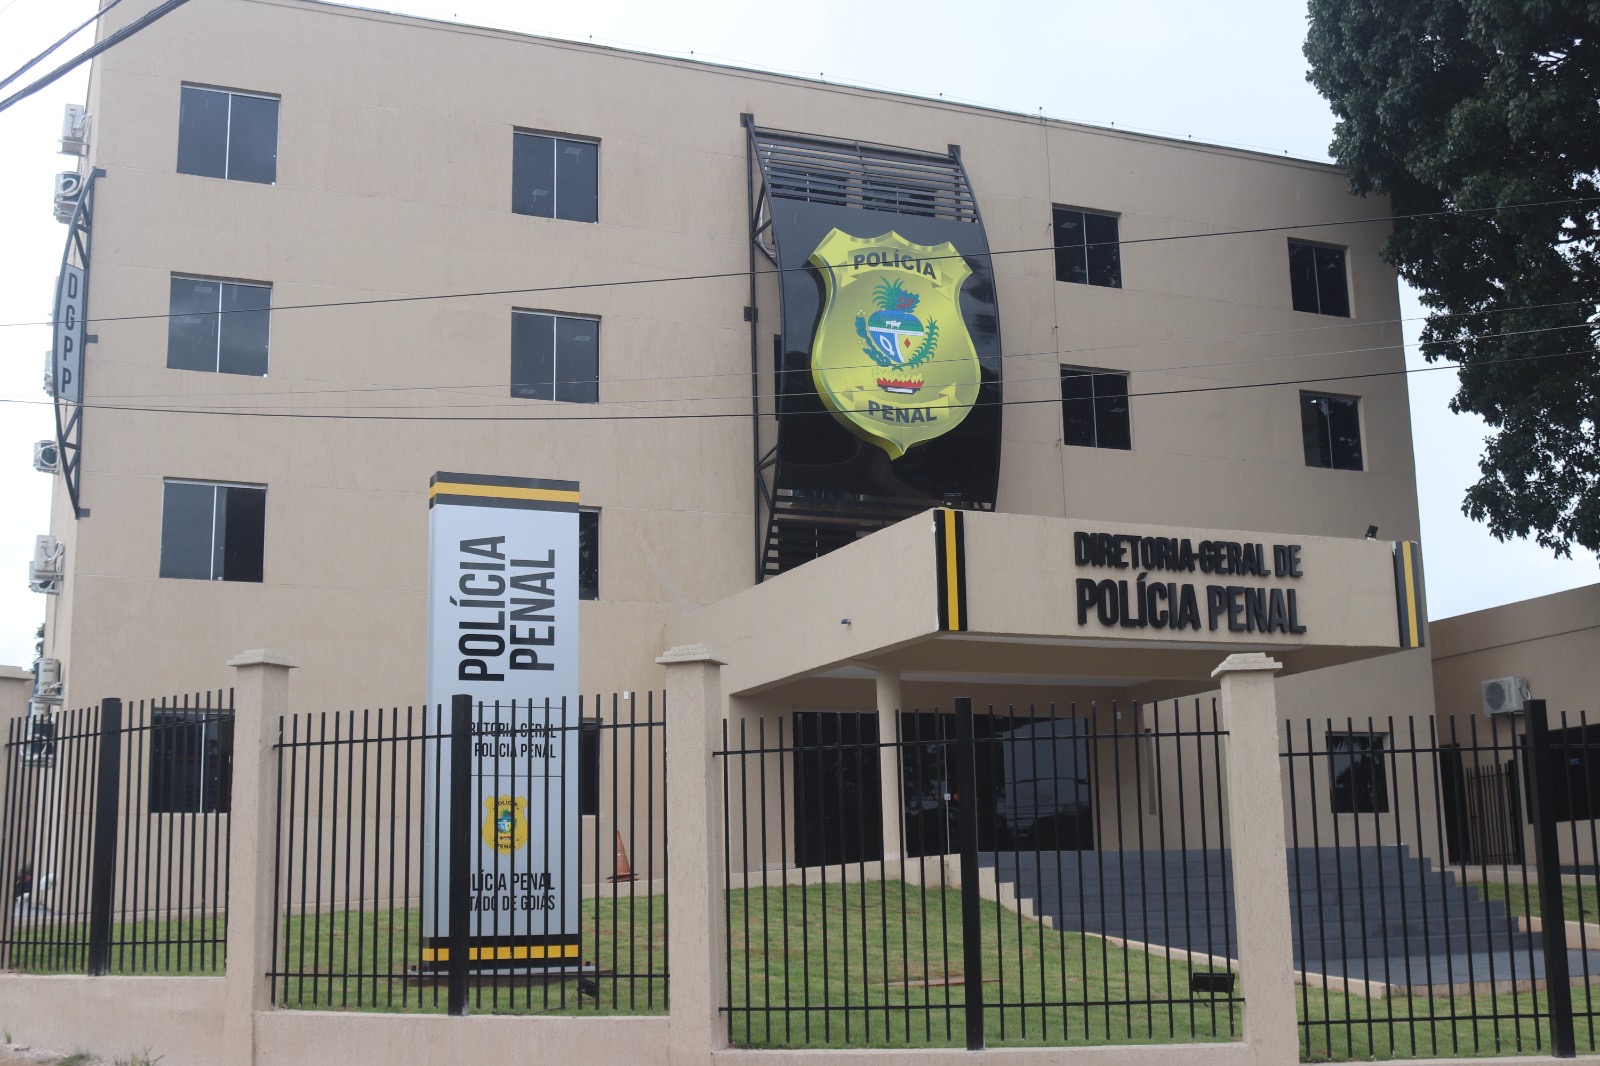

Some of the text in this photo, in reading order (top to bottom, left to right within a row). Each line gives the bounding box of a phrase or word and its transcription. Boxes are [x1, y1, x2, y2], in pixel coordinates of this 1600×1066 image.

[854, 250, 937, 280] POLÍCIA
[61, 272, 77, 393] DGPP
[868, 400, 937, 424] PENAL
[1274, 544, 1303, 577] DE
[450, 535, 505, 682] POLÍCIA
[509, 549, 555, 671] PENAL
[1076, 572, 1307, 634] POLÍCIA PENAL
[474, 743, 517, 758] POLCIA
[469, 870, 507, 891] LÍCA
[470, 895, 495, 911] TADO
